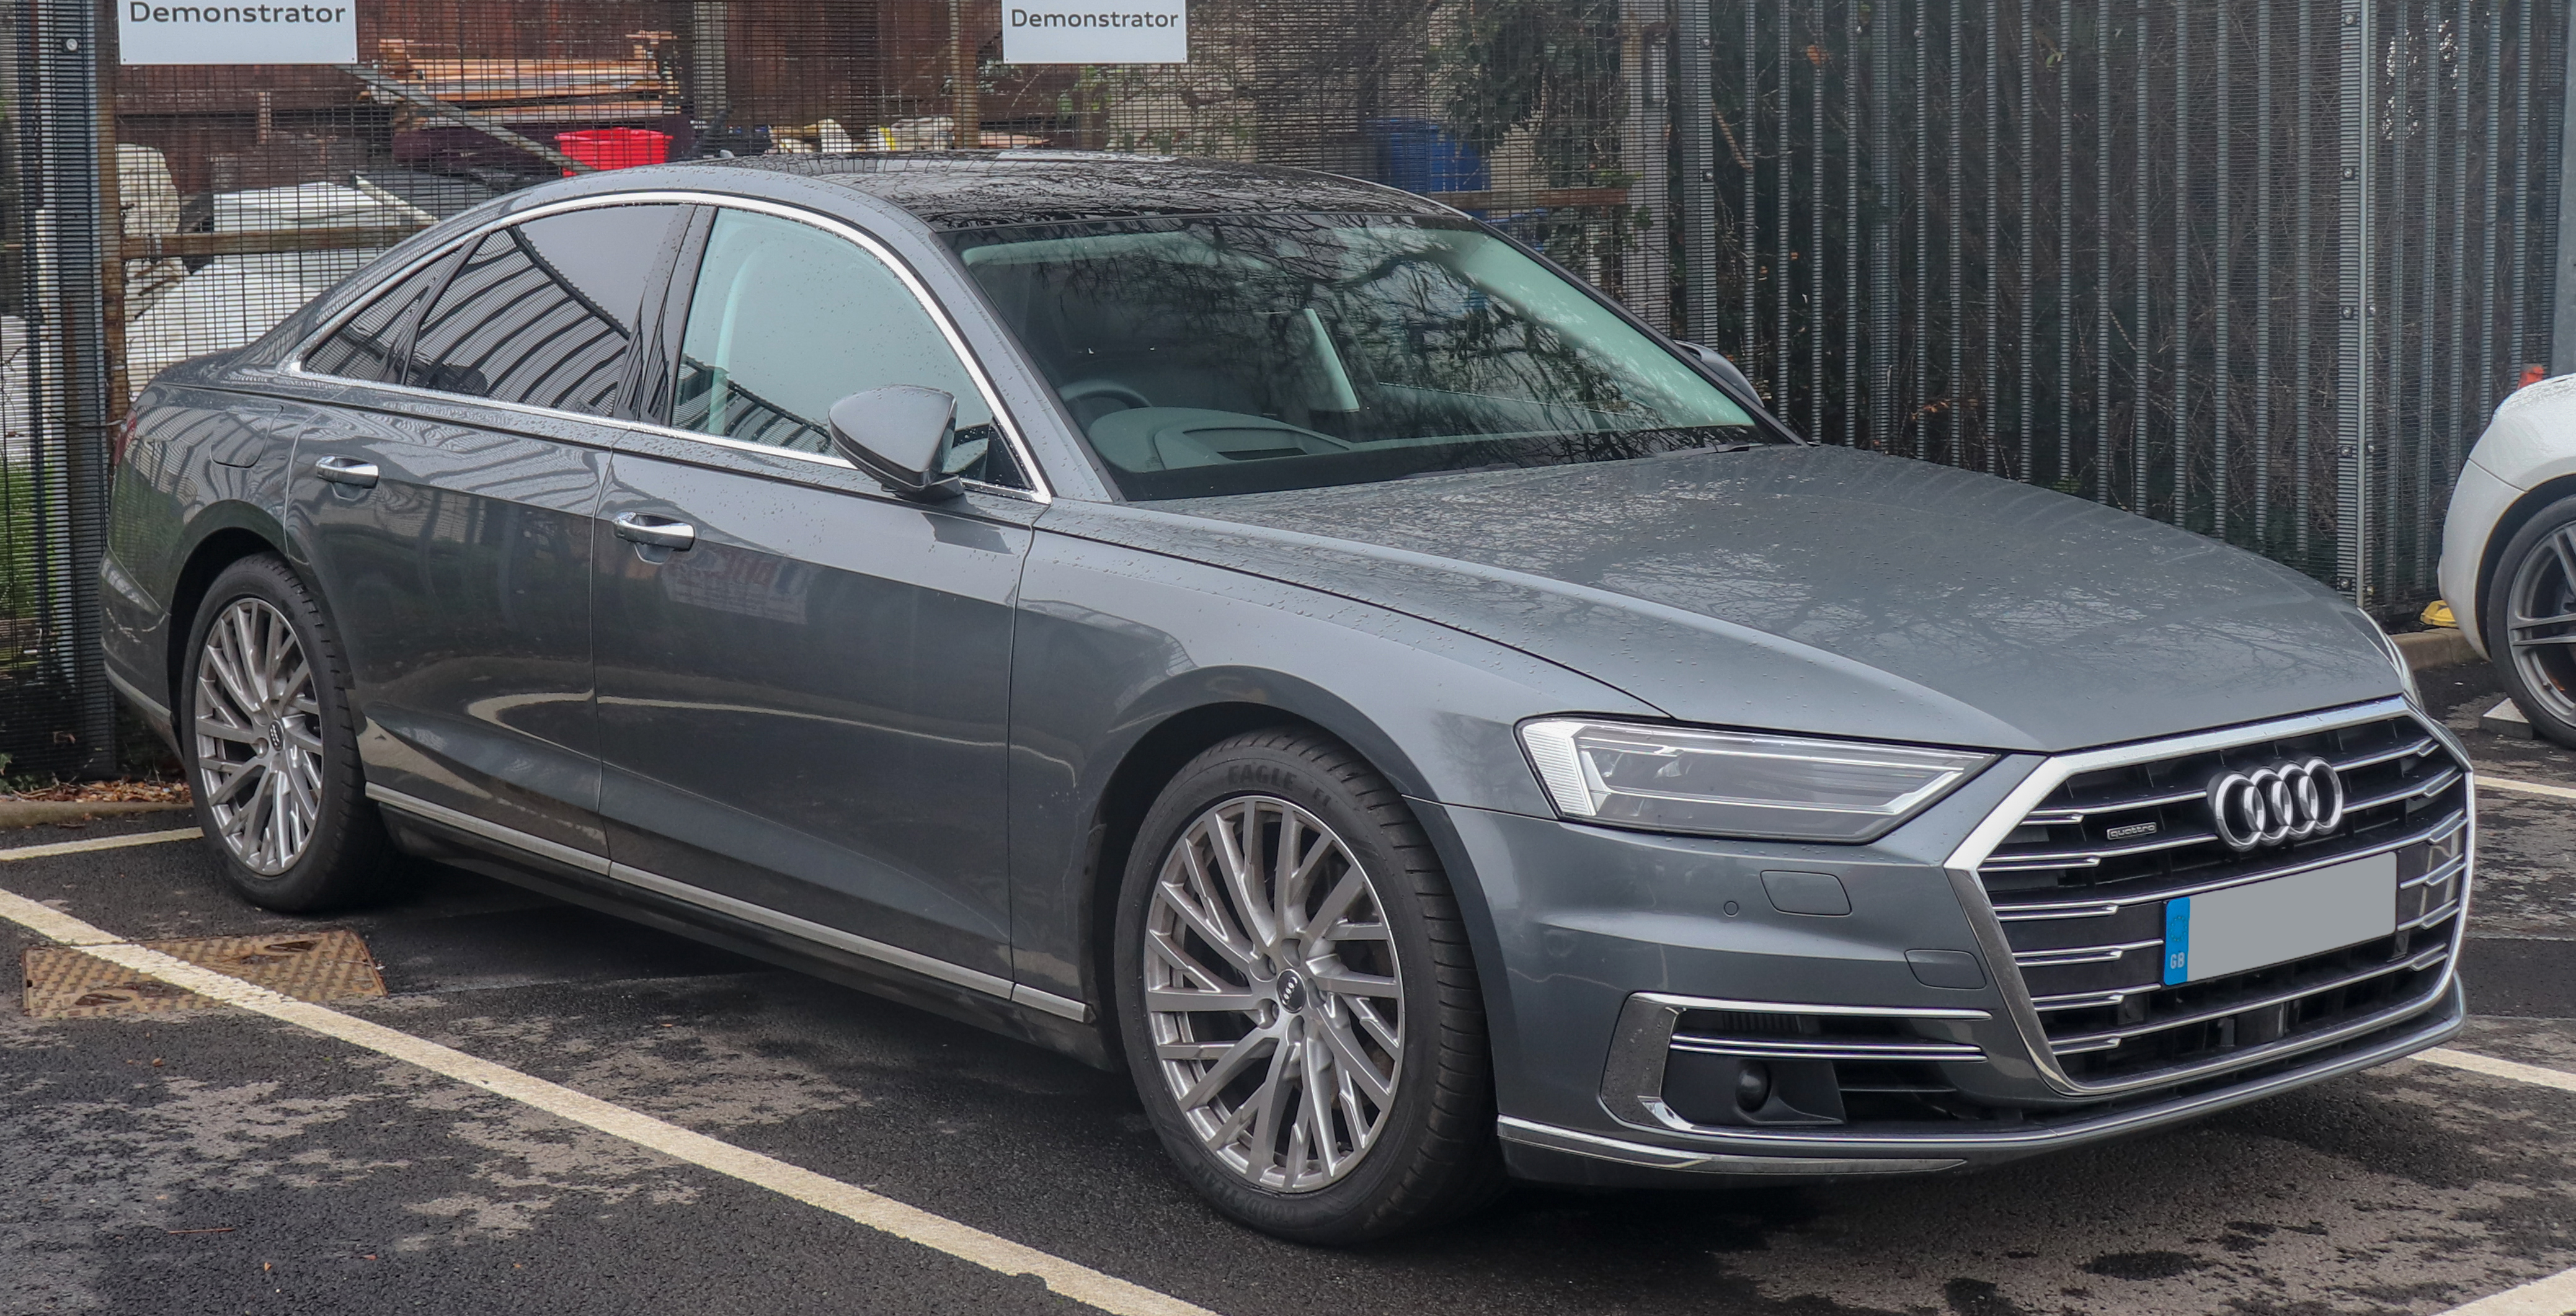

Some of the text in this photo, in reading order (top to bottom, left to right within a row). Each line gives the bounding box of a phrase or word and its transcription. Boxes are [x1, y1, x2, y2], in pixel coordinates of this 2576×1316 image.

[130, 1, 346, 22] Demonstrator
[1011, 9, 1178, 27] Demonstrator
[1227, 764, 1297, 791] EAGLE
[2110, 824, 2156, 838] quattro
[2170, 951, 2185, 969] GB
